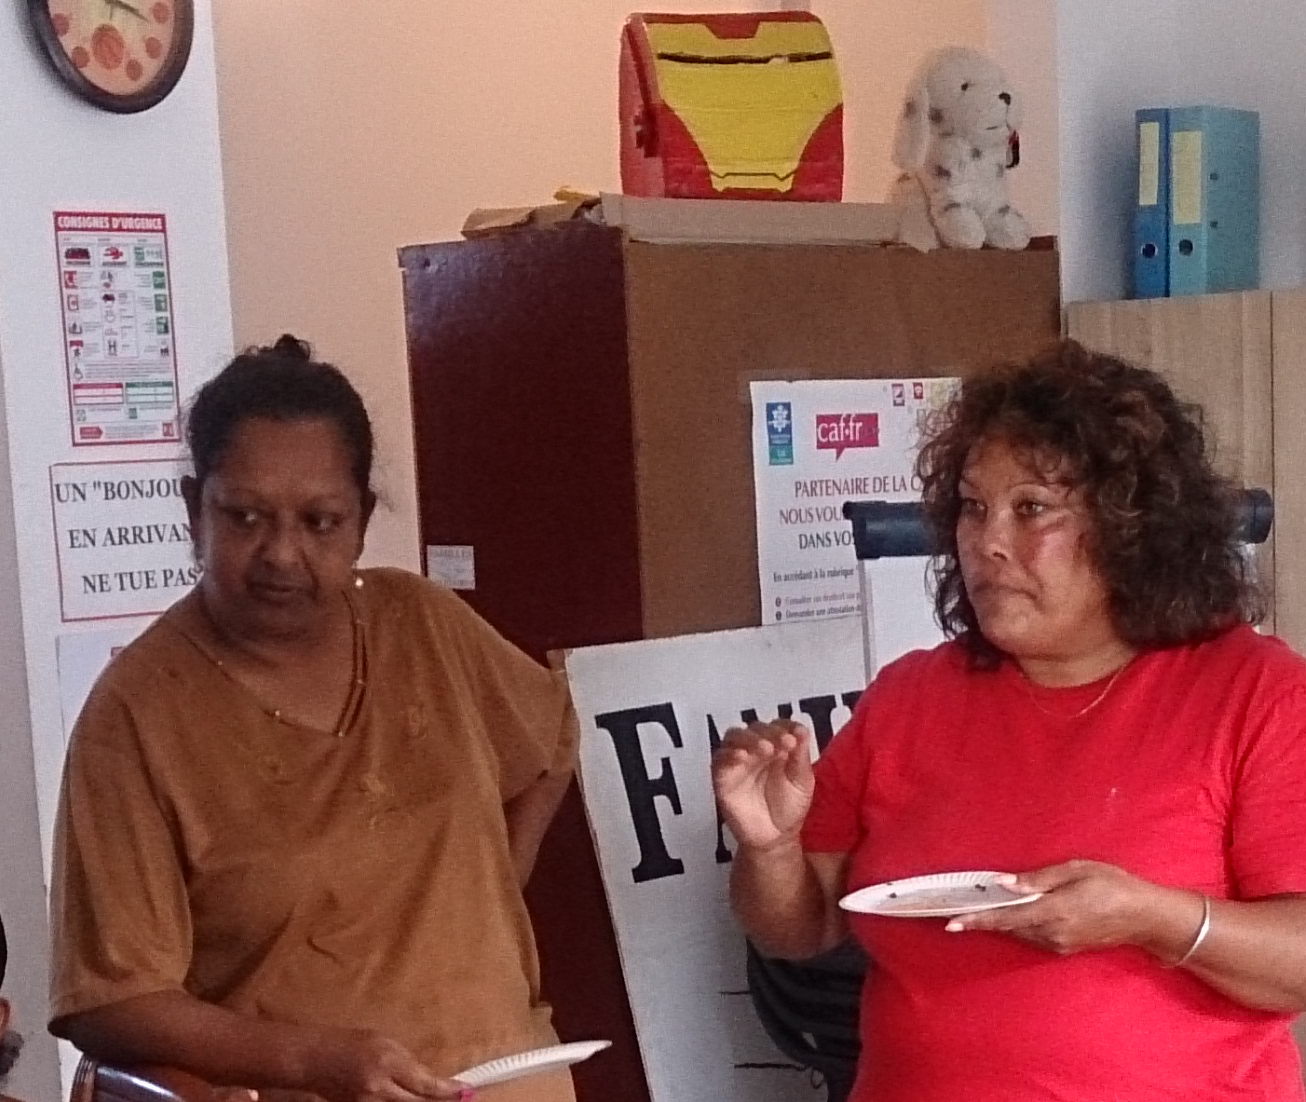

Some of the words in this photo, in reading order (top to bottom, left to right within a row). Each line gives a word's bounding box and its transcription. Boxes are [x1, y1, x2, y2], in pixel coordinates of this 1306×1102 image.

[57, 215, 110, 229] CONSIGNES
[111, 216, 163, 230] D'URGENCE
[55, 482, 87, 503] UN
[93, 477, 182, 501] "BONJOU
[794, 477, 869, 498] PARTENAIRE
[873, 475, 890, 493] DE
[893, 475, 907, 492] LA
[779, 507, 813, 525] NOUS
[815, 505, 843, 522] VOU
[67, 528, 97, 549] EN
[102, 522, 194, 548] ARRIVAN
[798, 531, 832, 550] DANS
[833, 529, 855, 547] VO
[82, 573, 112, 594] NE
[114, 570, 158, 592] TUE
[162, 566, 197, 588] PAS
[773, 571, 782, 583] En
